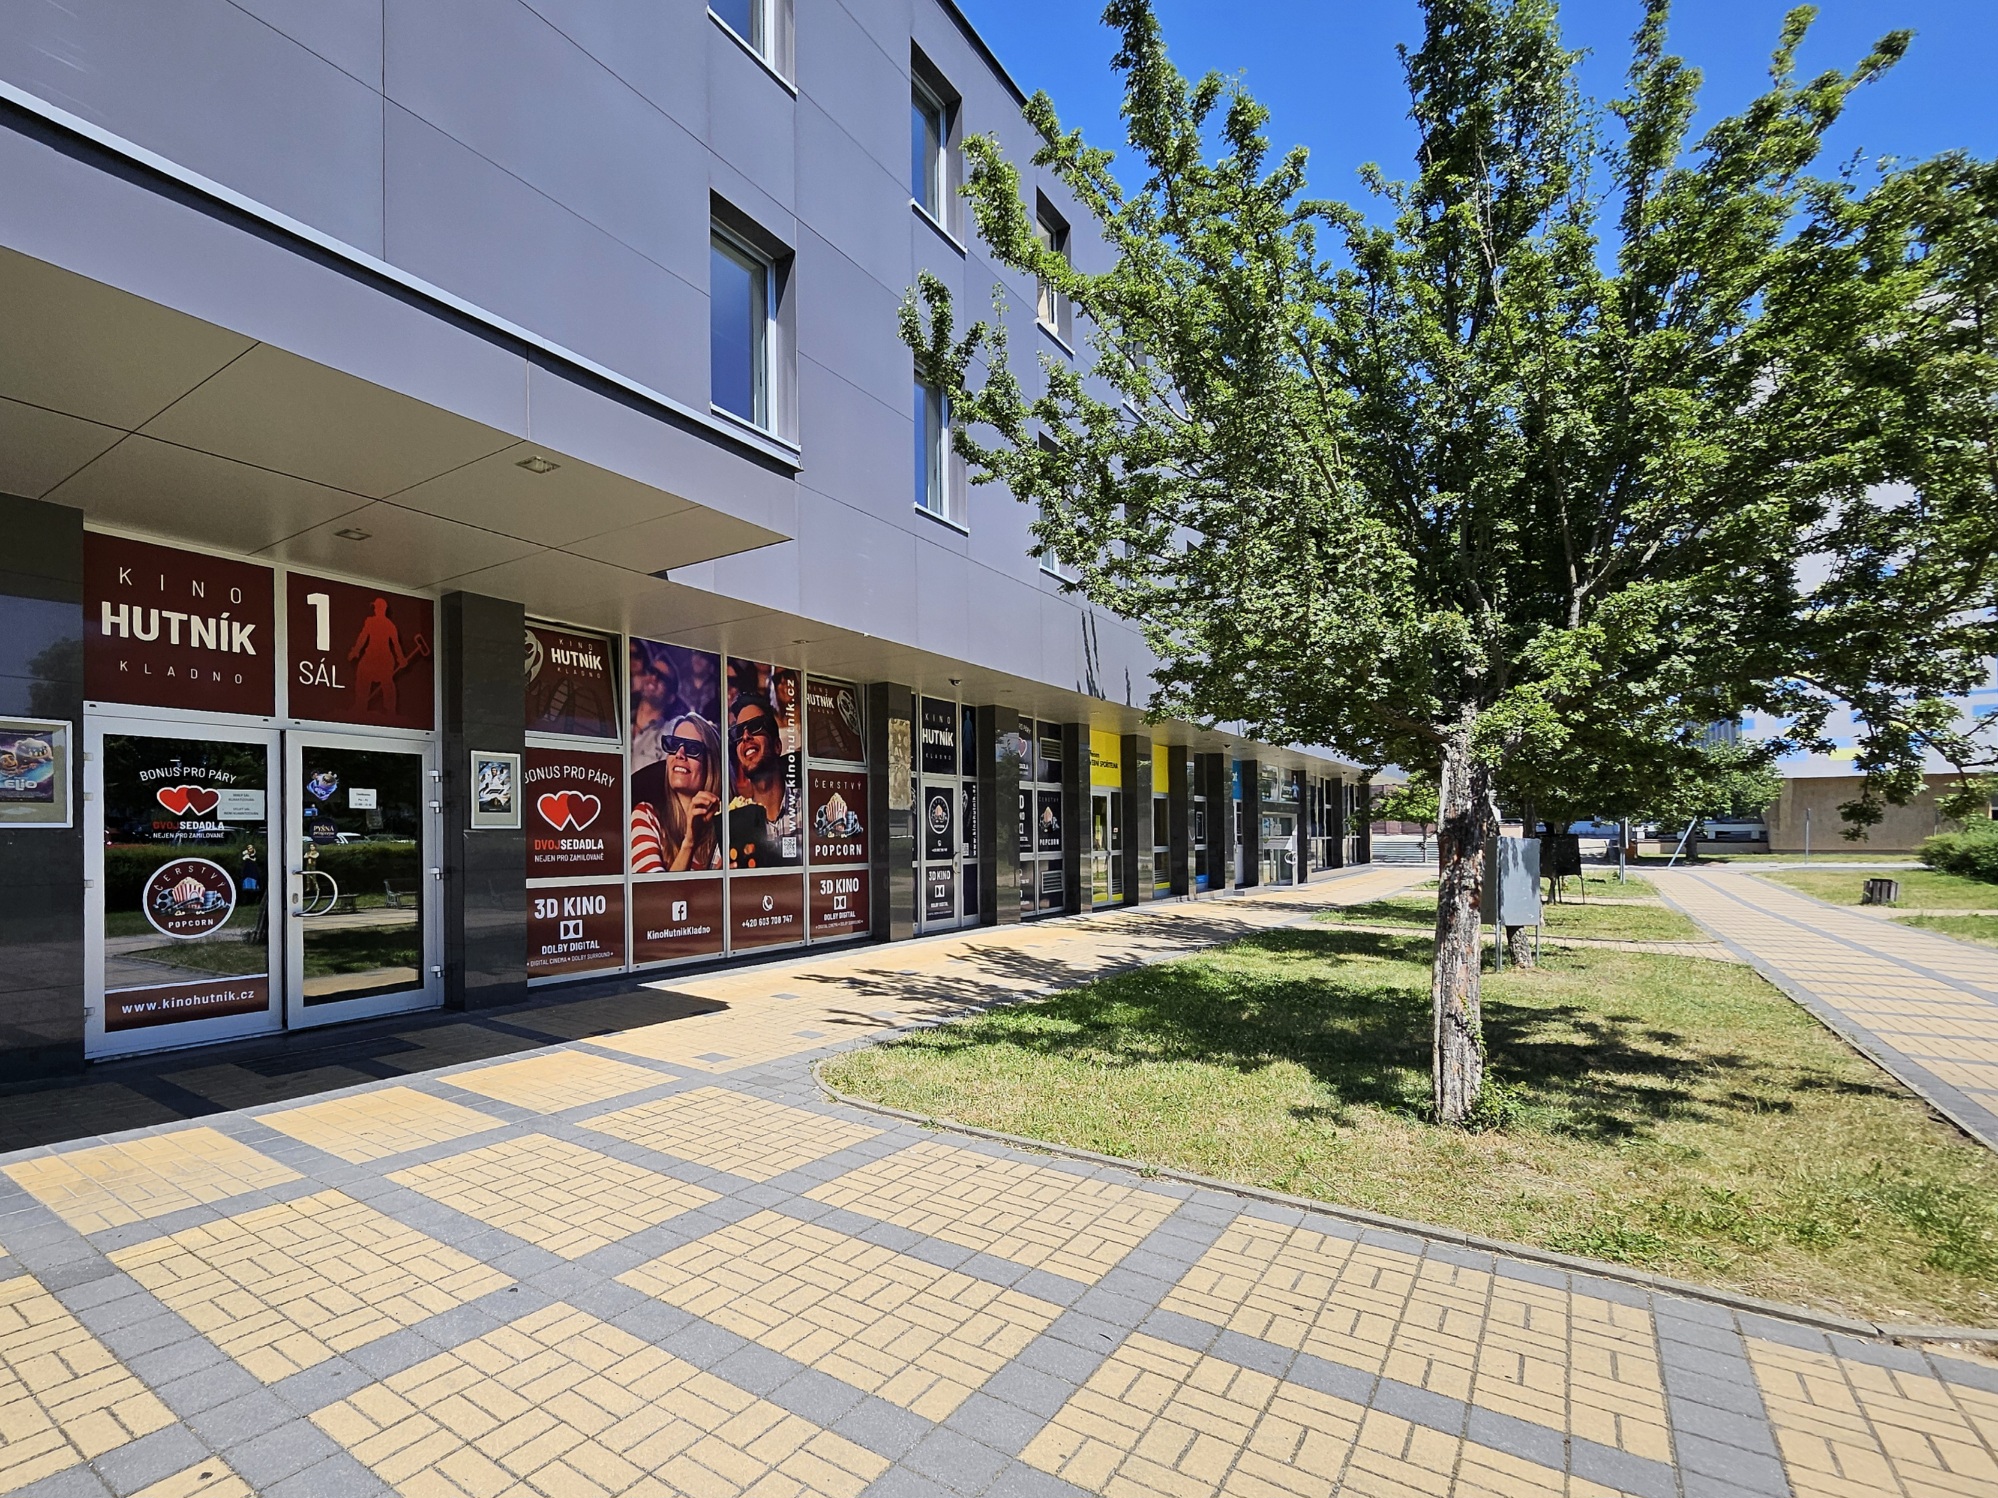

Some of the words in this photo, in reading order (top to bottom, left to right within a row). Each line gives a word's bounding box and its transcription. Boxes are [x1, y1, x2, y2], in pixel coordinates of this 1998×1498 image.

[119, 567, 242, 604] KINO
[101, 601, 256, 655] HUTNÍK
[307, 592, 330, 652] 1
[559, 639, 593, 650] KINO
[550, 647, 603, 671] HUTNÍK
[119, 660, 242, 685] KLADNO
[299, 658, 346, 689] SÁL
[925, 713, 951, 725] KINO
[922, 727, 954, 747] HUTNÍK
[785, 679, 796, 832] www.kinohutnik.cz
[139, 766, 181, 781] BONUS
[183, 767, 206, 778] PRO
[208, 769, 237, 784] PÁRY
[563, 766, 585, 780] PRO
[587, 768, 616, 788] PÁRY
[814, 778, 861, 790] ČERSTVÝ
[188, 831, 225, 839] ZAMILOVANÉ
[534, 838, 604, 850] DVOJSEDADLA
[534, 854, 556, 863] NEJEN
[556, 854, 569, 862] PRO
[569, 852, 604, 861] ZAMILOVANÉ
[815, 844, 862, 857] POPCORN
[153, 865, 225, 891] ČERSTVÝ
[820, 879, 834, 895] 3D
[835, 877, 859, 894] KINO
[534, 898, 559, 919] 3D
[563, 895, 606, 917] KINO
[168, 918, 214, 929] POPCORN
[741, 918, 758, 928] +420
[782, 914, 793, 924] 747
[647, 925, 711, 940] KinoHutnikKladno
[541, 943, 568, 955] DOLBY
[569, 940, 600, 952] DIGITAL
[530, 959, 549, 967] DIGITAL
[549, 957, 567, 965] CINEMA
[571, 954, 587, 962] DOLBY
[121, 990, 255, 1014] www.kinohutnik.cz
